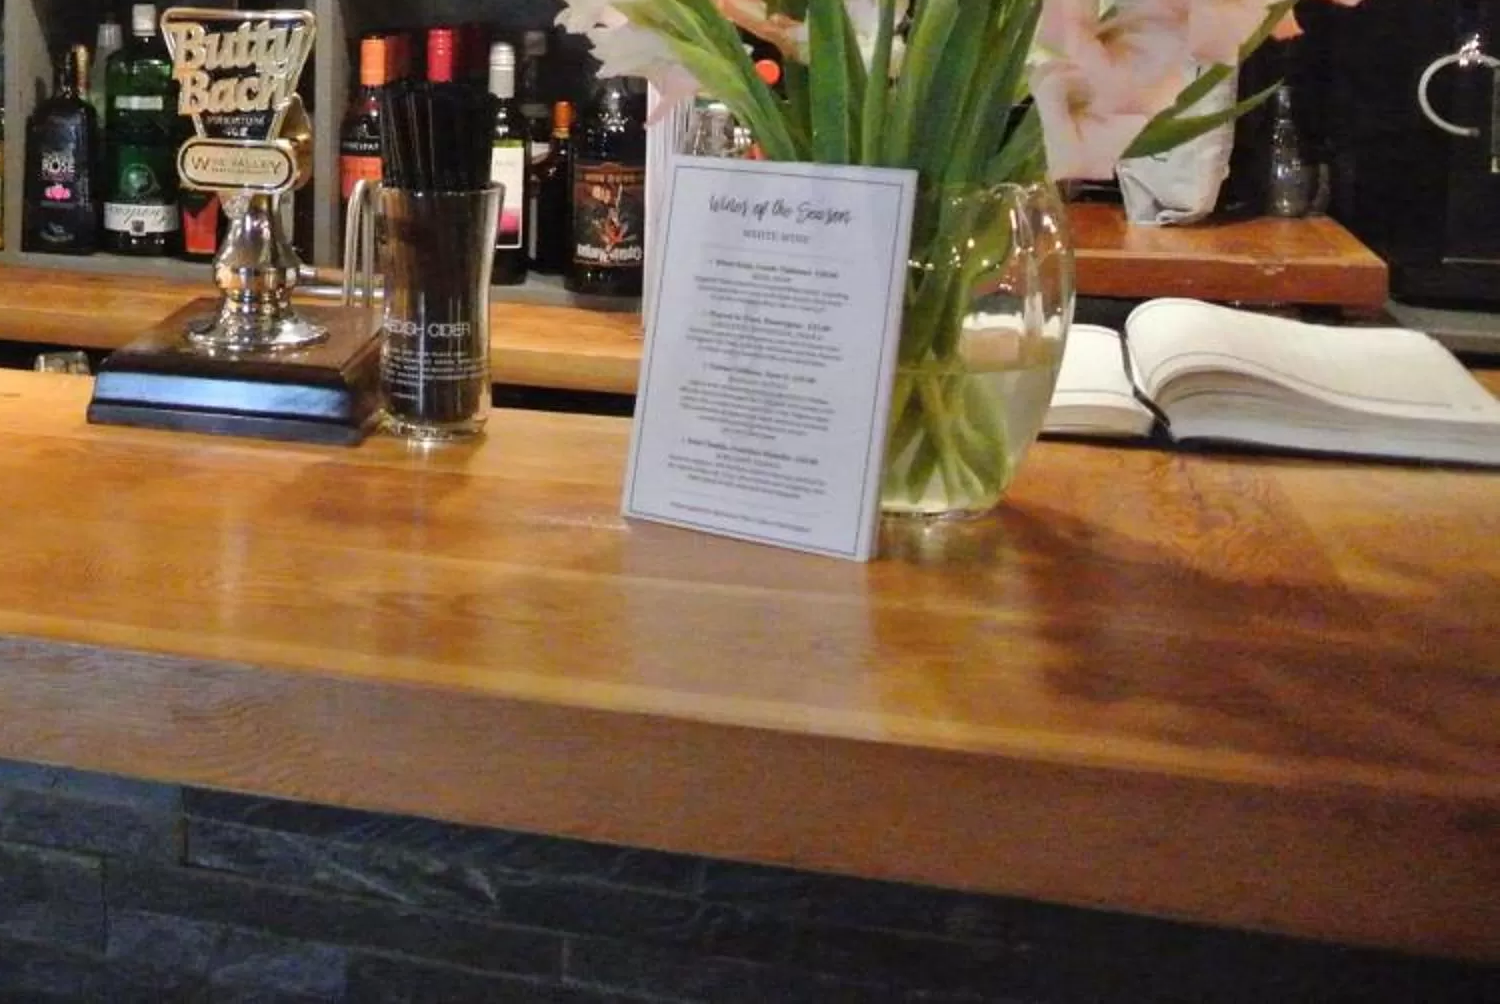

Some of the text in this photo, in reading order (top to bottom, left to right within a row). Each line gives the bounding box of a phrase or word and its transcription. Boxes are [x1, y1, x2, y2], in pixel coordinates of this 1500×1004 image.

[172, 20, 306, 75] Butty
[177, 67, 291, 115] Bach
[427, 321, 471, 338] CIDER
